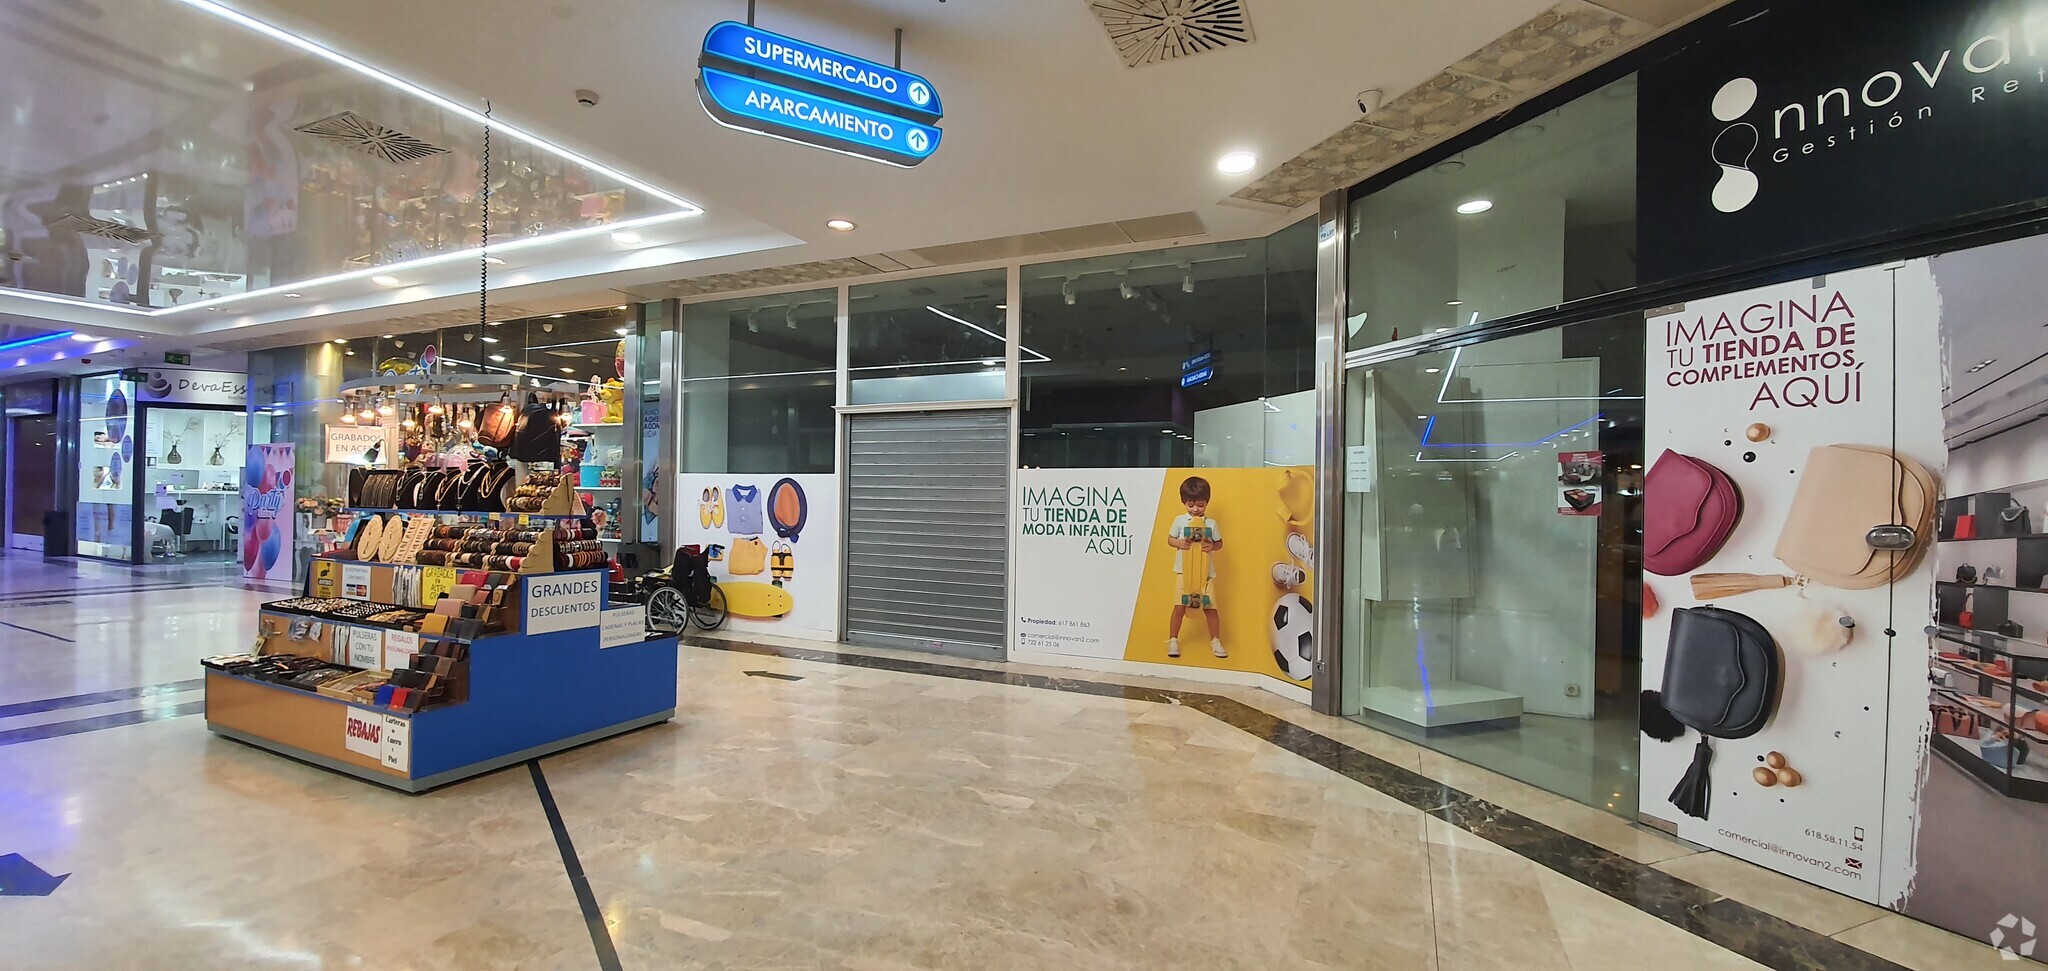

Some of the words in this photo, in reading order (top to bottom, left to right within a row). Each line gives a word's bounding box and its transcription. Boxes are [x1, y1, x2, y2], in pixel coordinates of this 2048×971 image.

[744, 36, 898, 94] SUPERMERCADO
[745, 89, 894, 141] APARCAMIENTO
[1772, 105, 1932, 163] Gestión
[1666, 290, 1855, 347] IMAGINA
[1666, 347, 1694, 369] TU
[1703, 330, 1805, 364] TIENDA
[1816, 322, 1855, 349] DE
[1666, 348, 1856, 387] COMPLEMENTOS
[1749, 361, 1865, 411] AQUÍ
[350, 445, 371, 453] ACE
[1023, 485, 1128, 507] IMAGINA
[1022, 507, 1040, 522] TU
[1043, 507, 1101, 523] TIENDA
[1106, 508, 1127, 524] DE
[1022, 523, 1065, 536] MODA
[1069, 524, 1127, 538] INFANTIL
[1084, 534, 1133, 556] AQUÍ
[531, 580, 598, 598] GRANDES
[531, 601, 596, 618] DESCUENTOS
[352, 629, 378, 642] PULSERAS
[353, 653, 376, 666] NOMBRE
[347, 717, 381, 744] REBAJAS
[1804, 828, 1863, 852] 618.58.11.54
[1717, 828, 1862, 881] comercial@innovan2.com
